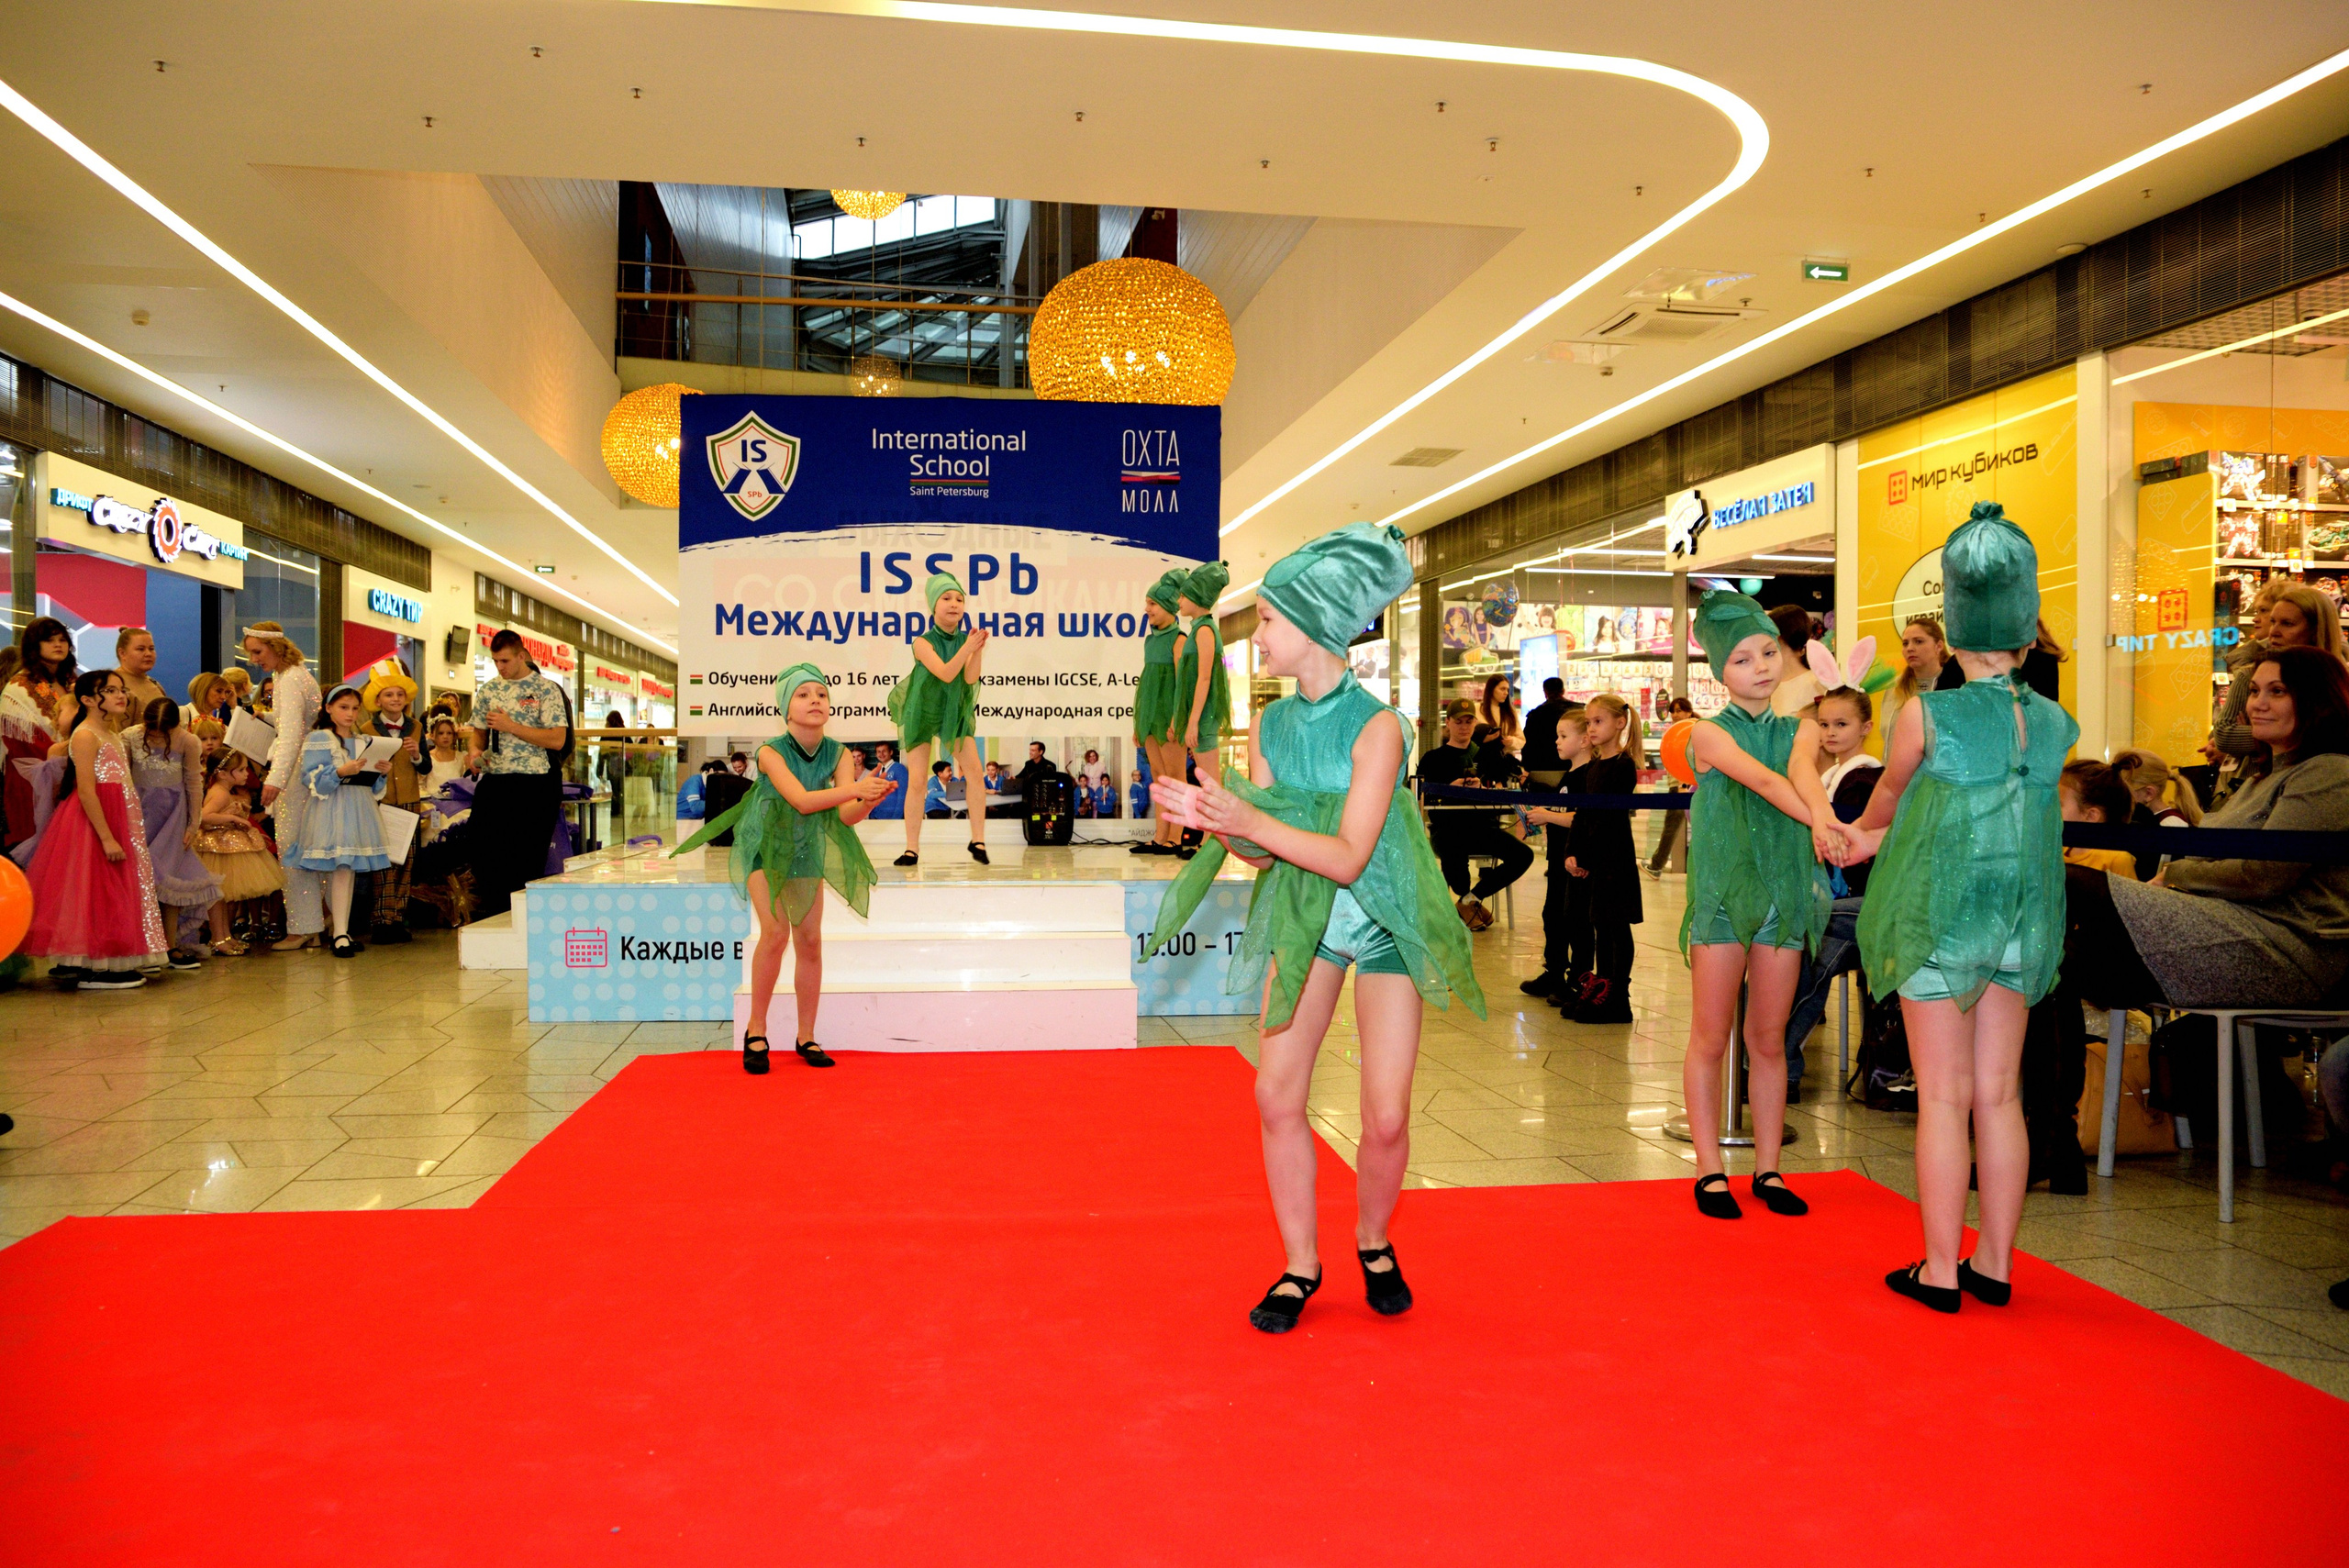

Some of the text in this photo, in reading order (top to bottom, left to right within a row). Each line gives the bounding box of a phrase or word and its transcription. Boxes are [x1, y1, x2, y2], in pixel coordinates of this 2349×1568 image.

[740, 439, 768, 462] IS
[872, 428, 1027, 451] International
[1121, 429, 1180, 466] ОХТА
[909, 454, 990, 476] School
[1951, 443, 2039, 484] кубиков
[56, 488, 94, 512] ДРИФТ
[747, 490, 763, 498] SPb
[909, 485, 990, 498] Saint Petersburg
[1121, 489, 1179, 513] МОЛЛ
[1711, 481, 1814, 530] ВЕСЁЛАЯ ЗАТЕЯ
[220, 541, 250, 562] КАРТИНГ
[372, 587, 404, 618] CRAZY
[715, 603, 1179, 644] Междунардная школ
[707, 671, 778, 688] Обучени
[847, 672, 867, 685] 16
[872, 674, 900, 685] лет
[978, 673, 1141, 688] кзамены IGCSE, A-Le
[707, 703, 896, 719] Английск ограмм
[1108, 706, 1134, 720] сре
[620, 935, 725, 964] Каждые
